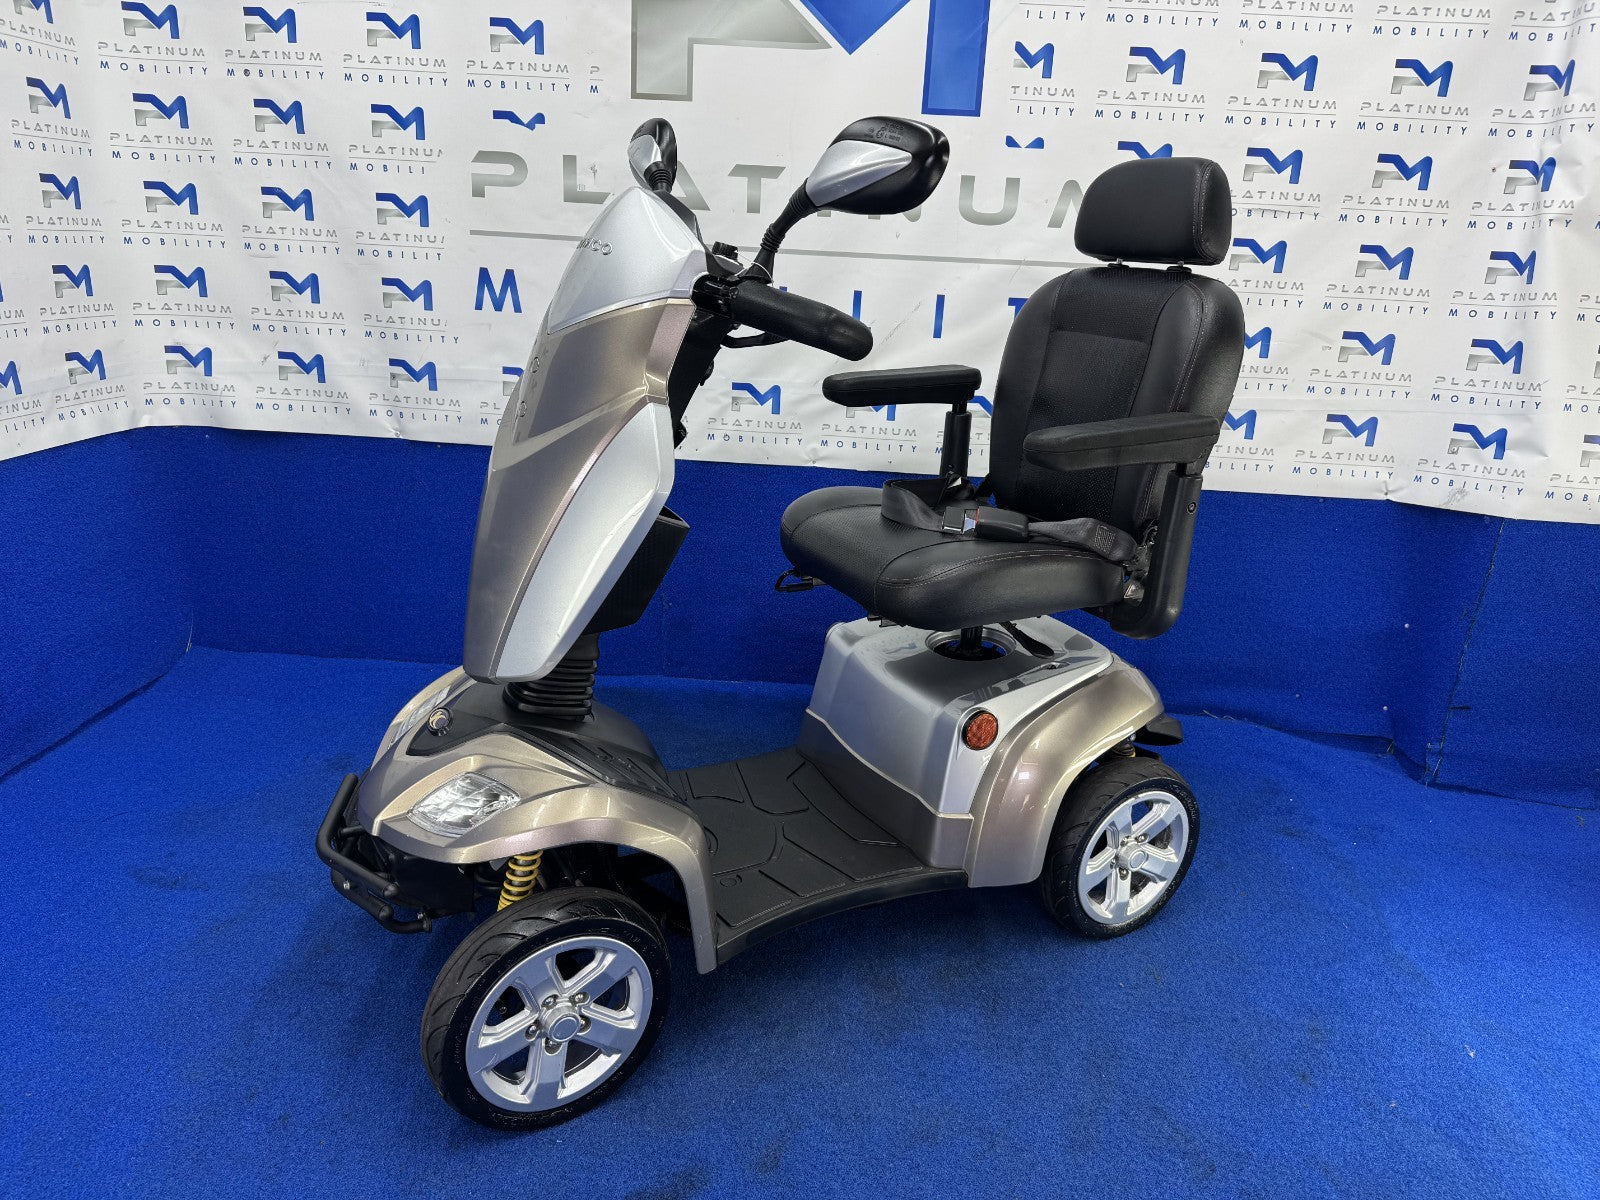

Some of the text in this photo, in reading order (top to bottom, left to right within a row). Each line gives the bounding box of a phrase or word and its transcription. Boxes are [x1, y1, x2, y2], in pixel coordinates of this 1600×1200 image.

[1026, 10, 1085, 21] ILITY
[1376, 5, 1491, 18] PLATINUM
[1513, 3, 1595, 21] PLATINU
[1106, 13, 1219, 26] MOBILITY
[1239, 19, 1352, 33] MOBILITY
[1373, 26, 1489, 39] MOBILITY
[1509, 25, 1594, 42] MOBILIT
[0, 39, 79, 65] MOBILITY
[98, 41, 205, 56] PLATINUM
[225, 49, 322, 61] PLATINUM
[343, 54, 446, 68] PLATINUM
[466, 60, 569, 74] PLATINUM
[100, 61, 207, 75] MOBILITY
[227, 68, 325, 80] MOBILITY
[344, 73, 447, 87] MOBILITY
[467, 79, 571, 92] MOBILITY
[1010, 86, 1075, 97] TINUM
[1097, 90, 1205, 103] PLATINUM
[1228, 96, 1336, 109] PLATINUM
[1360, 102, 1469, 116] PLATINUM
[1016, 106, 1075, 116] ILITY
[1095, 109, 1204, 122] MOBILITY
[1492, 102, 1596, 119] PLATINUM
[11, 119, 90, 138] PLATINUM
[1225, 115, 1335, 129] MOBILITY
[1357, 121, 1467, 135] MOBILITY
[1488, 123, 1594, 137] MOBILITY
[110, 132, 213, 146] PLATINUM
[233, 139, 329, 152] PLATINUM
[14, 139, 92, 157] MOBILITY
[112, 150, 216, 163] MOBILITY
[235, 156, 331, 169] MOBILITY
[350, 162, 425, 174] MOBILI
[1230, 189, 1320, 202] LATINUM
[1342, 195, 1450, 209] PLATINUM
[1471, 200, 1575, 212] PLATINUM
[1231, 208, 1319, 220] OBILITY
[1339, 214, 1447, 227] MOBILITY
[26, 215, 101, 227] PLATINUM
[121, 219, 223, 231] PLATINUM
[1467, 219, 1572, 230] MOBILITY
[242, 224, 338, 238] PLATINUM
[356, 231, 445, 244] PLATINU
[28, 235, 104, 244] MOBILITY
[123, 236, 226, 248] MOBILITY
[244, 242, 340, 255] MOBILITY
[358, 249, 442, 261] MOBILIT
[1229, 279, 1304, 290] ATINUM
[1327, 284, 1430, 297] PLATINUM
[1452, 291, 1558, 301] PLATINUM
[40, 303, 114, 316] PLATINUM
[132, 302, 232, 314] PLATINUM
[1246, 298, 1303, 308] ILITY
[1323, 302, 1428, 314] MOBILITY
[251, 307, 344, 320] PLATINUM
[364, 313, 447, 327] PLATINU
[1449, 309, 1556, 319] MOBILITY
[43, 320, 117, 334] MOBILITY
[134, 319, 235, 330] MOBILITY
[253, 324, 346, 336] MOBILITY
[364, 331, 459, 344] MOBILITY
[1241, 365, 1288, 375] INUM
[1309, 369, 1412, 382] PLATINUM
[143, 382, 236, 393] PLATINUM
[1244, 383, 1287, 391] LITY
[1435, 376, 1542, 391] PLATINUM
[55, 384, 125, 403] PLATINUM
[256, 386, 348, 399] PLATINUM
[1307, 386, 1410, 399] MOBILITY
[145, 398, 236, 408] MOBILITY
[369, 393, 461, 408] PLATINUM
[1431, 394, 1541, 409] MOBILITY
[58, 401, 129, 421] MOBILITY
[256, 403, 350, 415] MOBILITY
[370, 409, 462, 423] MOBILITY
[5, 417, 46, 432] ILITY
[707, 418, 802, 430] PLATINUM
[822, 423, 917, 437] PLATINUM
[707, 434, 802, 444] MOBILITY
[821, 440, 917, 452] MOBILITY
[1214, 445, 1274, 456] TINUM
[1295, 450, 1395, 463] PLATINUM
[1205, 462, 1273, 472] BILITY
[1292, 467, 1393, 479] MOBILITY
[1418, 459, 1525, 478] PLATINUM
[1414, 475, 1523, 495] MOBILITY
